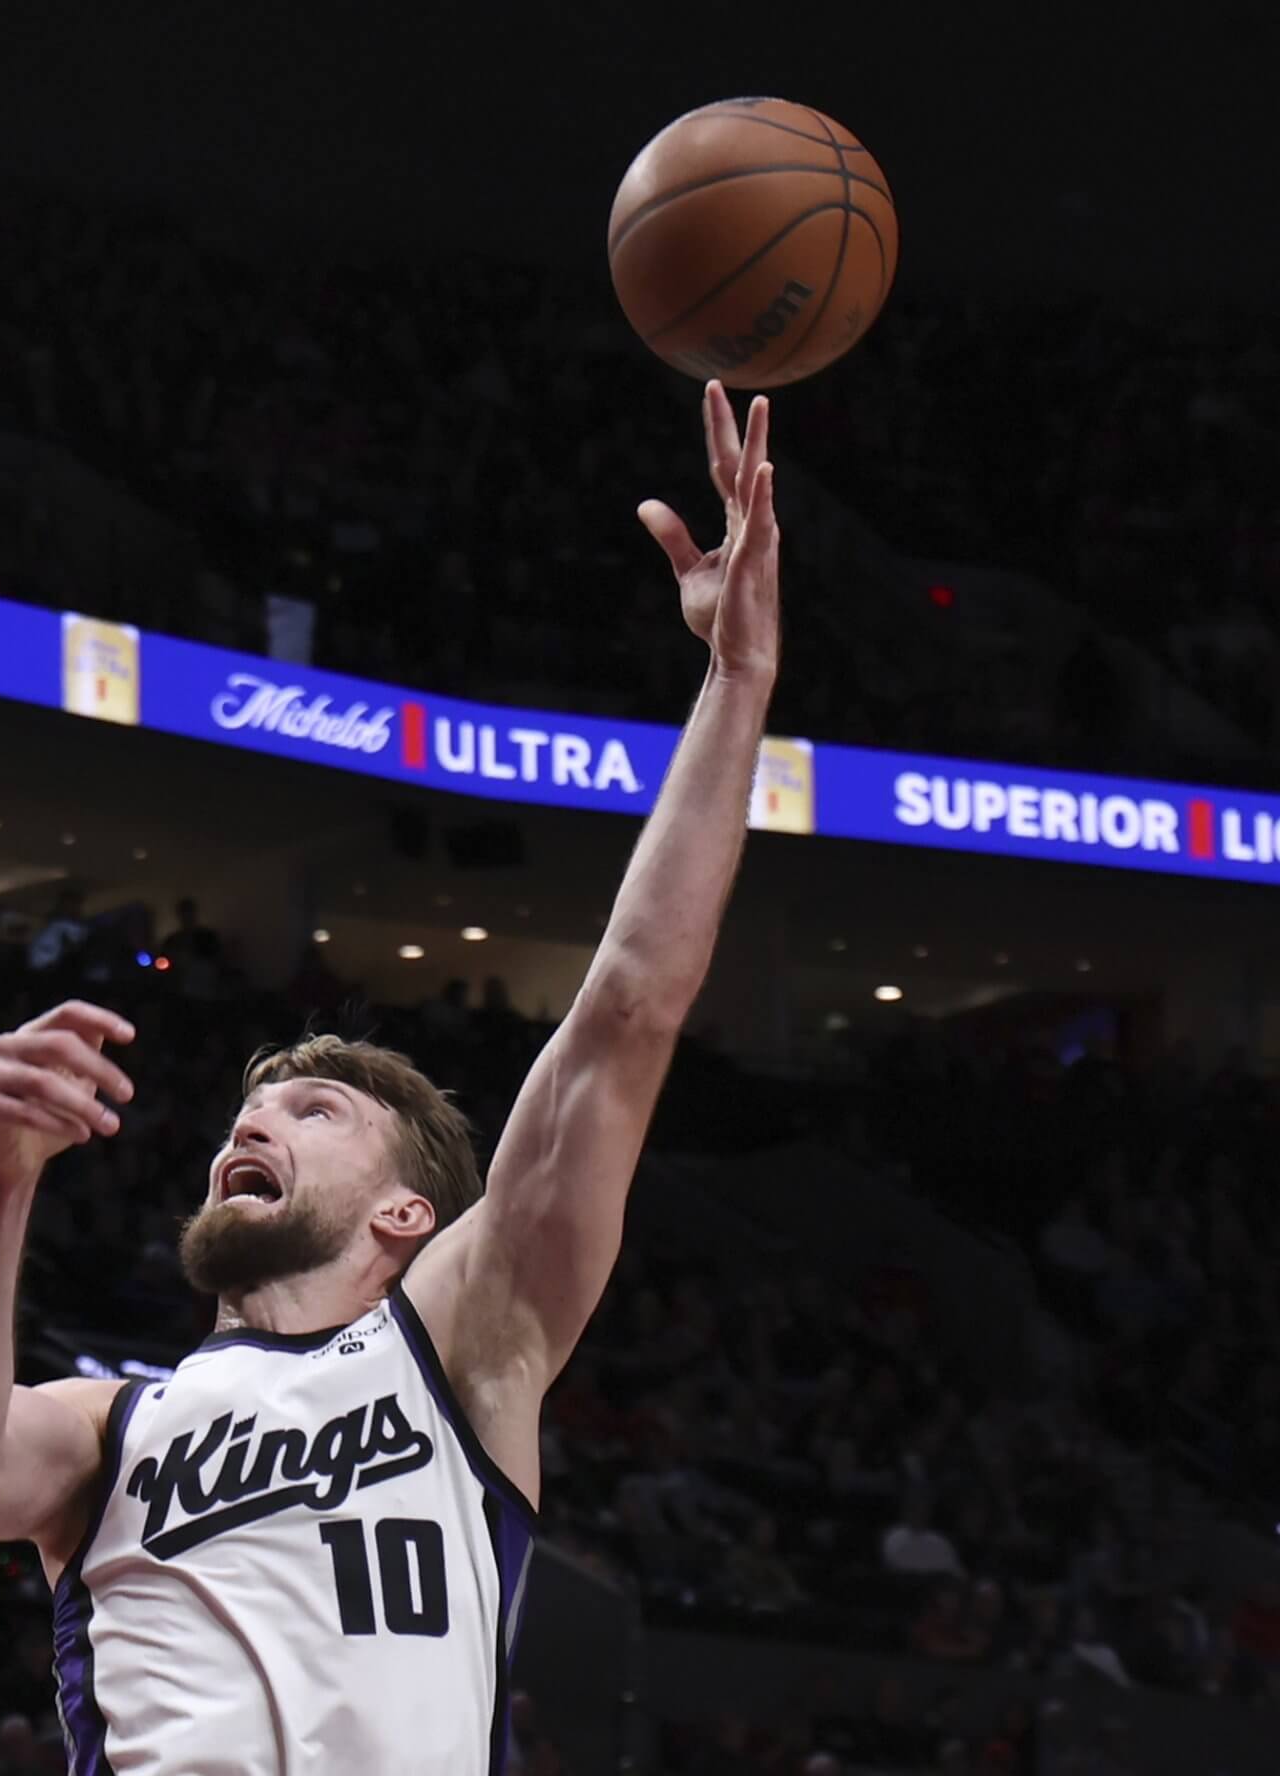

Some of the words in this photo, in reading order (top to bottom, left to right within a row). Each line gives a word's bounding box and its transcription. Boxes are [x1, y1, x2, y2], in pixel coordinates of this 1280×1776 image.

[210, 672, 395, 754] Michelob
[434, 716, 641, 794] ULTRA
[894, 772, 1180, 853] SUPERIOR
[1221, 808, 1280, 865] LI
[126, 1393, 434, 1561] Kings
[319, 1518, 450, 1638] 10
